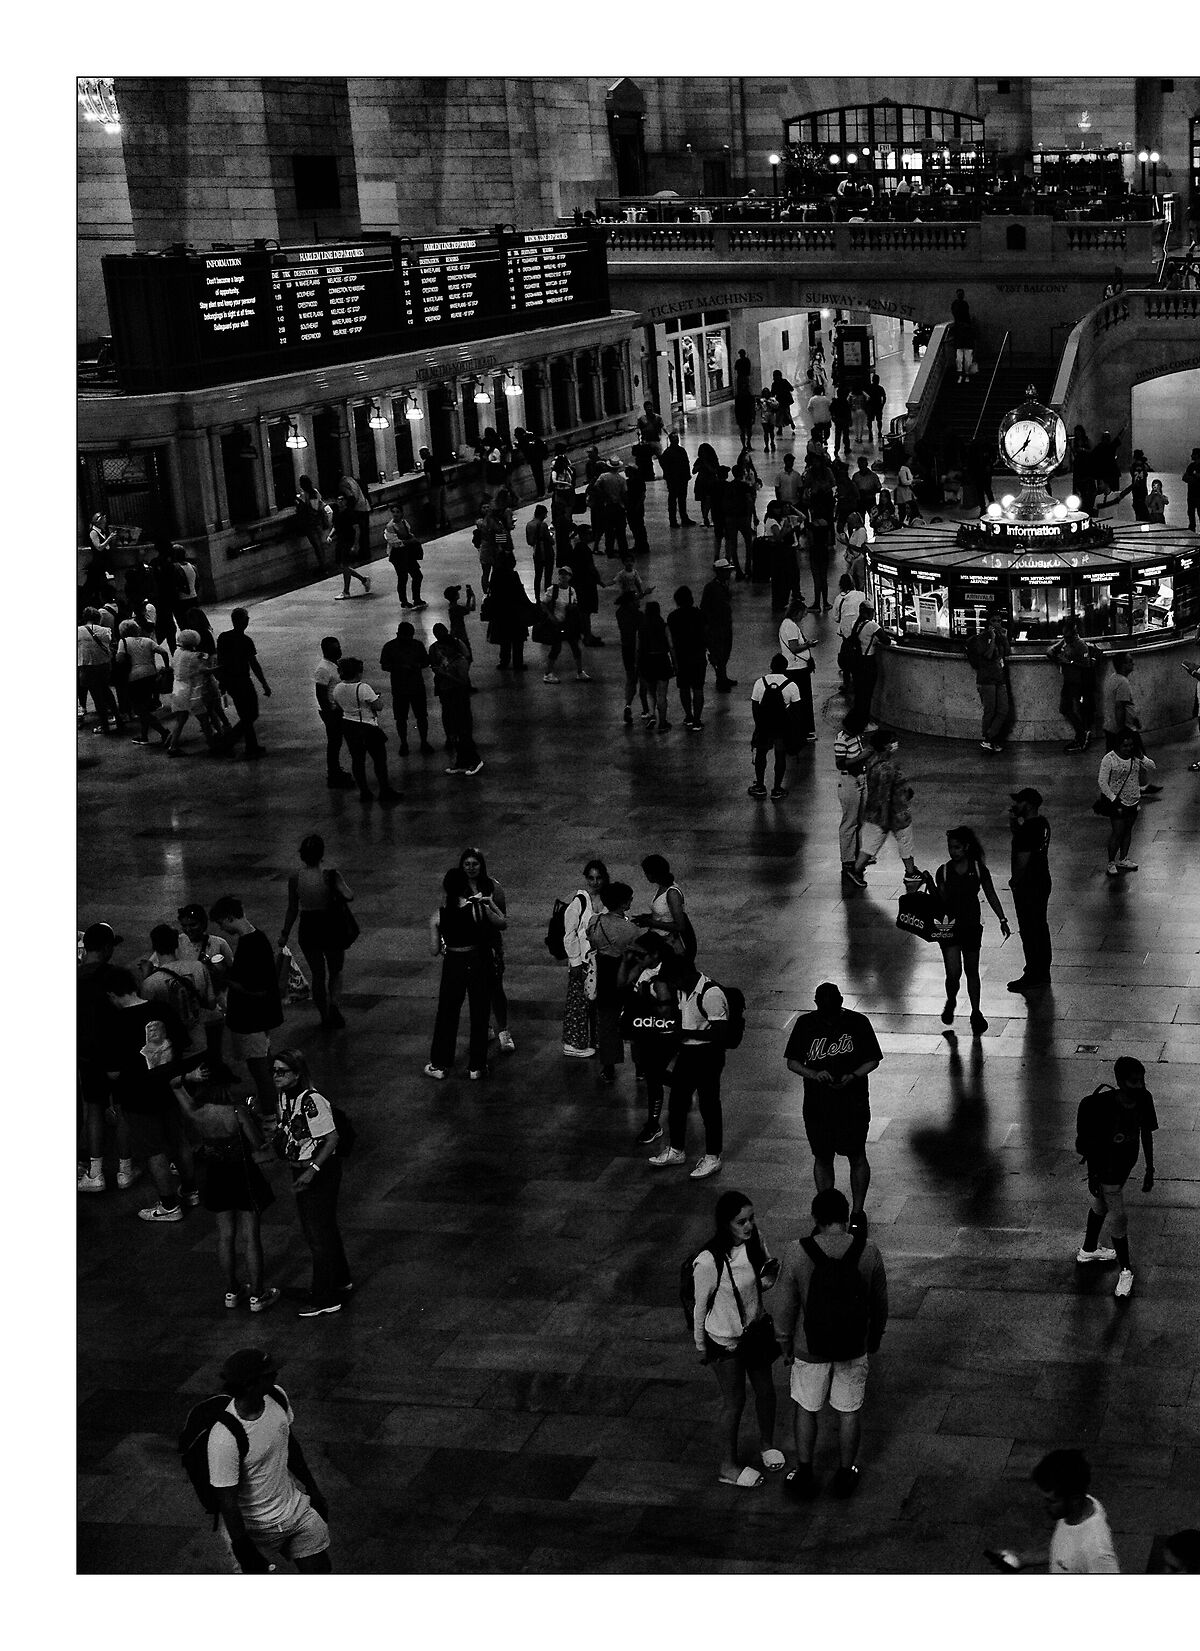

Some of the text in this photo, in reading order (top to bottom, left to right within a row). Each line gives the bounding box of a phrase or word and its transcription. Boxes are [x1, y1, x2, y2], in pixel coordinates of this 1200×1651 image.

[1024, 284, 1068, 293] BALCONY
[648, 291, 764, 319] TICKET MACHINES
[805, 292, 916, 317] SUBWAY 42ND ST
[1136, 363, 1169, 380] DINING
[1007, 525, 1060, 536] Information
[806, 1034, 854, 1061] Mets
